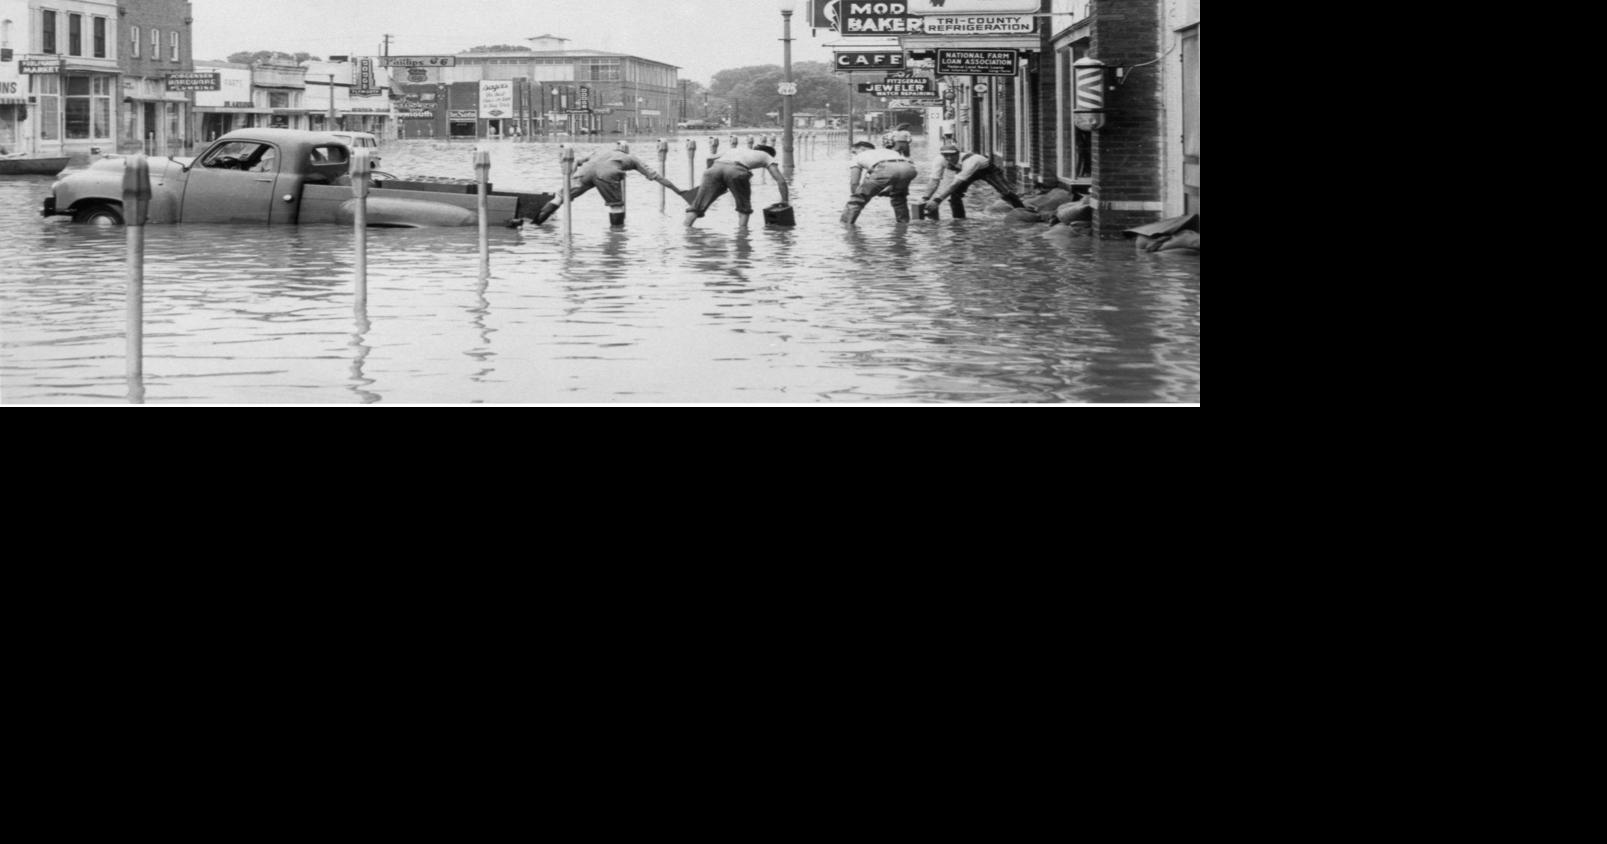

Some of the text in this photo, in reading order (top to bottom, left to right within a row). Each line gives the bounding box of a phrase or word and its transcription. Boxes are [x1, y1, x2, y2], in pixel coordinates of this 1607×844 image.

[847, 17, 925, 31] BAKER
[936, 16, 1022, 25] TRI-COUNTY
[928, 24, 1030, 32] REFRIGERATION
[837, 55, 903, 66] CAFE
[964, 58, 1013, 66] ASSOCIATION
[22, 66, 60, 74] MARKET
[167, 78, 217, 86] HARDWARE
[0, 81, 17, 94] NS
[865, 84, 925, 92] JEWELER
